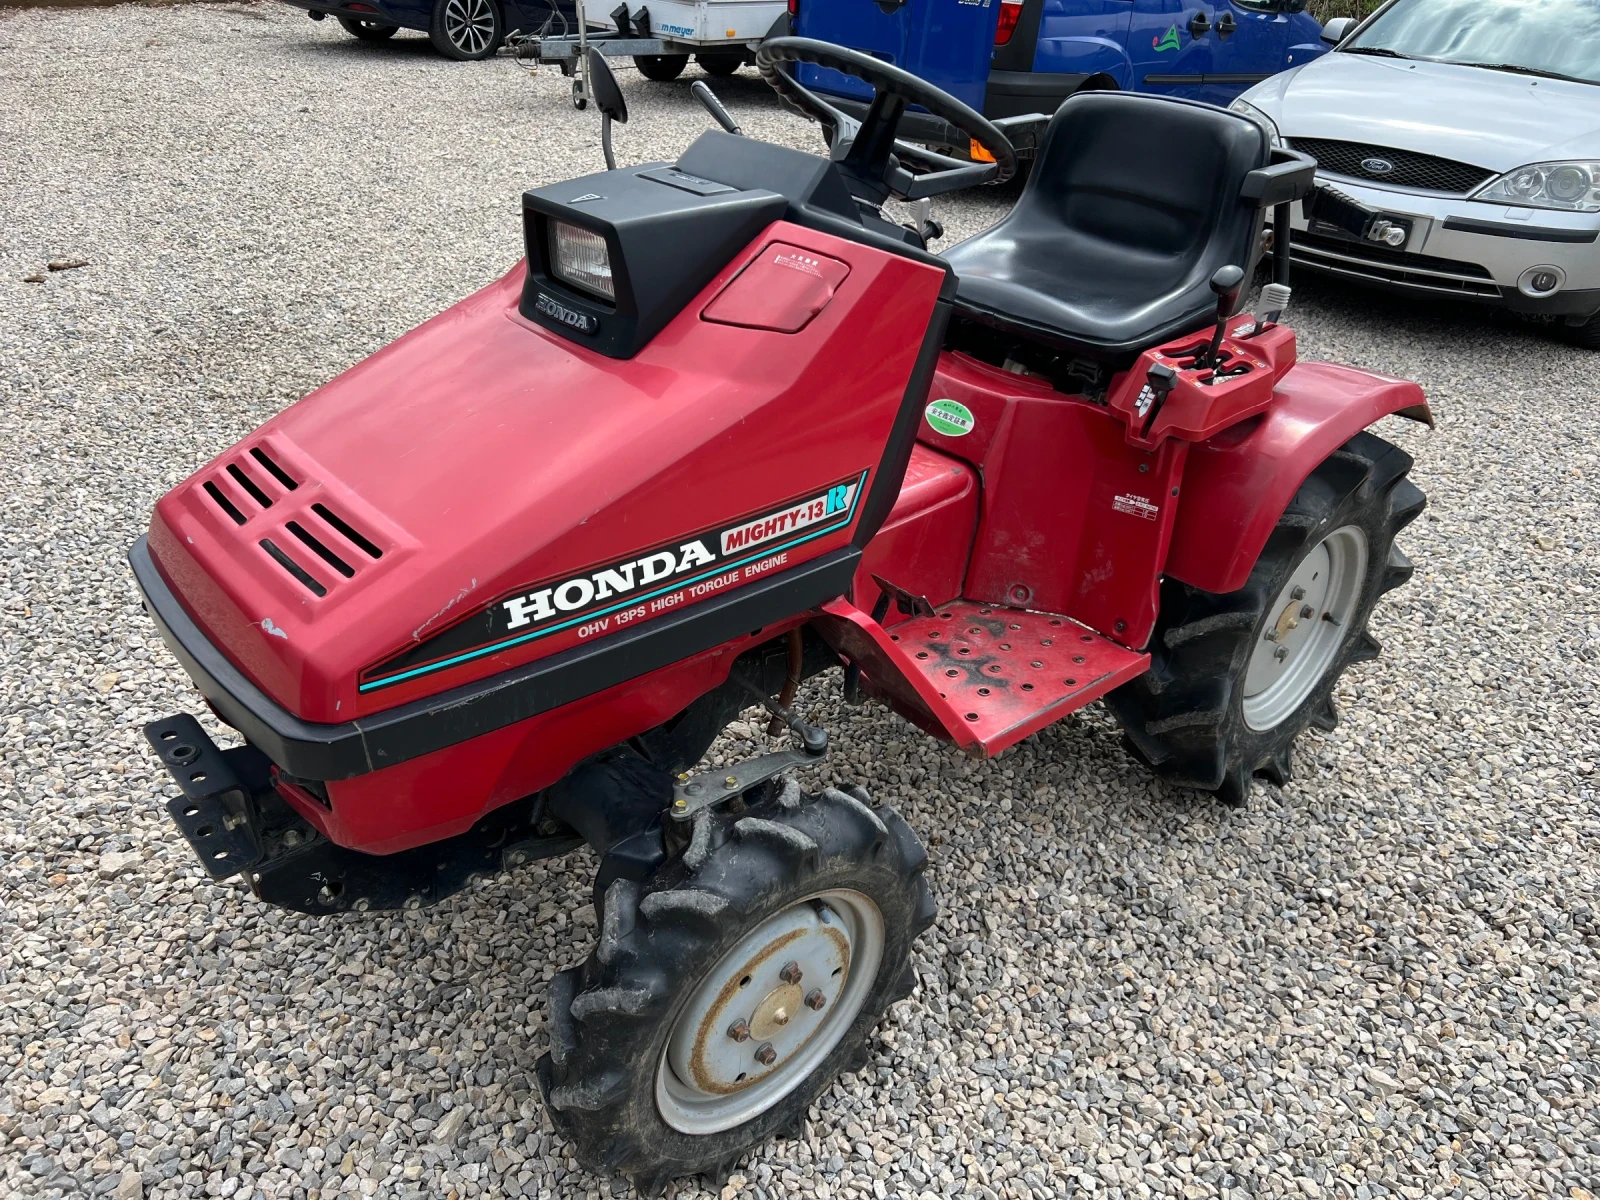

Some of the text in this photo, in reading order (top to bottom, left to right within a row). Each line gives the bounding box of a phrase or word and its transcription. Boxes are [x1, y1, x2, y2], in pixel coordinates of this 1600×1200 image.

[535, 299, 589, 330] HONDA
[725, 501, 824, 551] MIGHTY-13
[503, 540, 716, 630] HONDA
[578, 553, 788, 638] OHV 13PS HIGH TORQUE ENGINE
